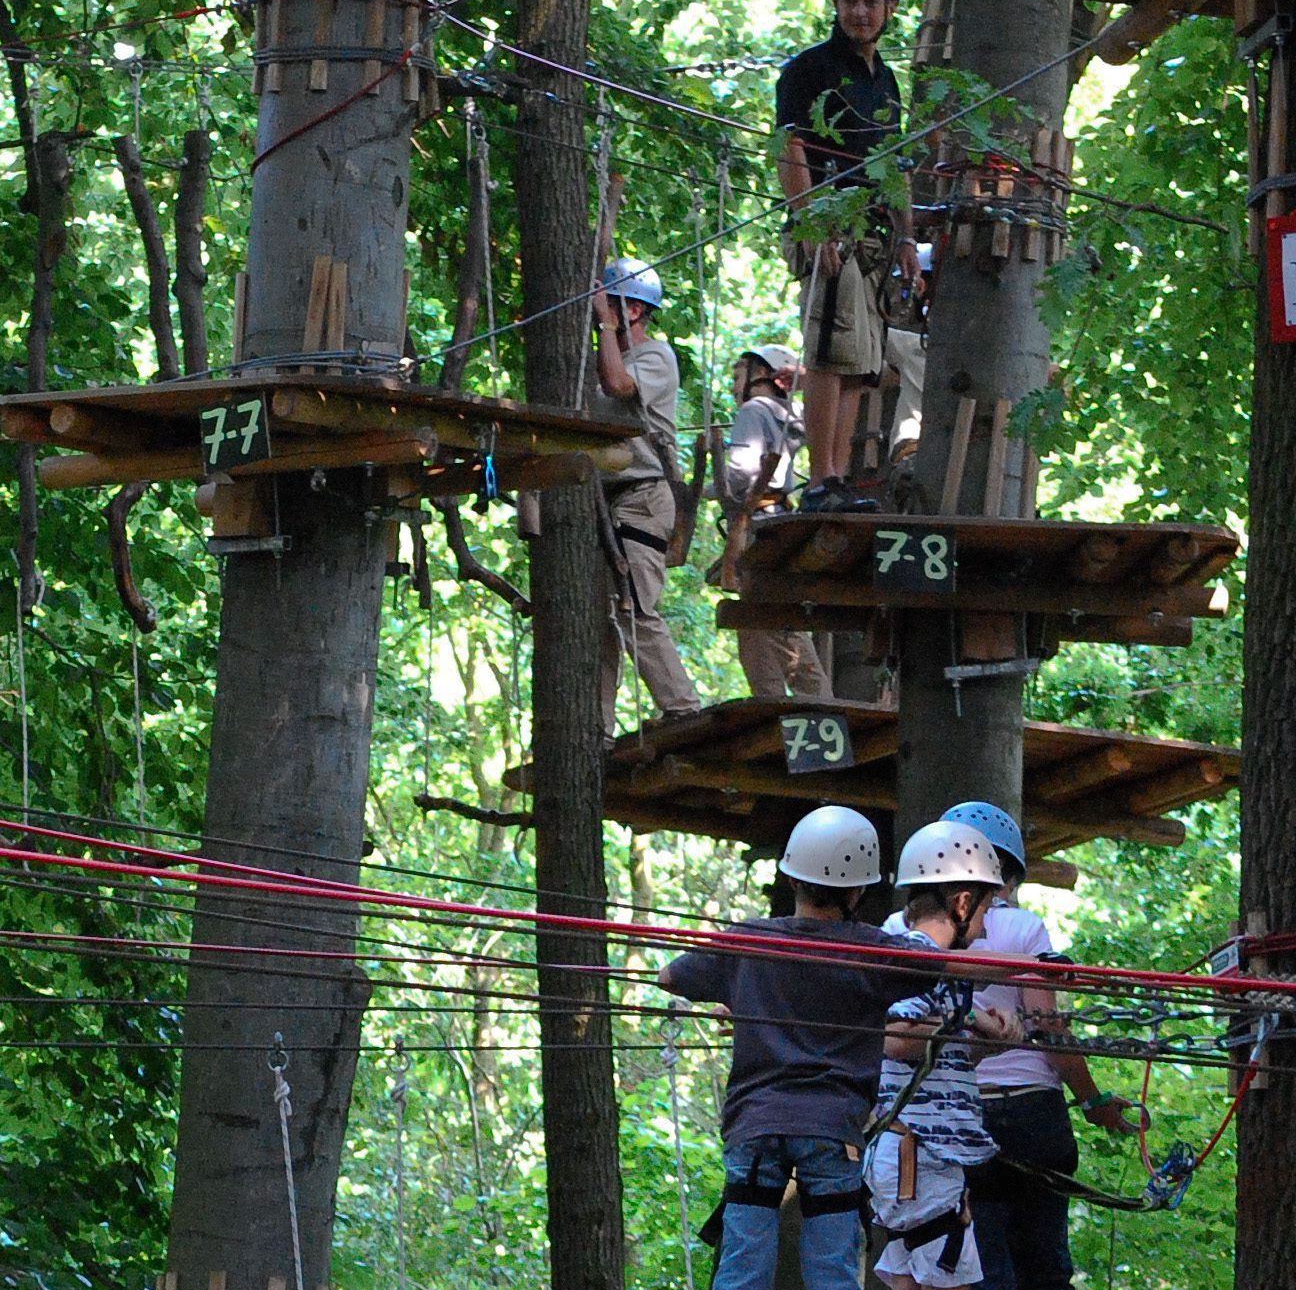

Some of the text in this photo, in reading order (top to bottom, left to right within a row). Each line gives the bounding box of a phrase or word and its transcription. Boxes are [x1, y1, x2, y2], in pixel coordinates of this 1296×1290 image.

[201, 399, 262, 465] 7-7
[876, 530, 949, 581] 7-8
[781, 718, 845, 762] 7-9
